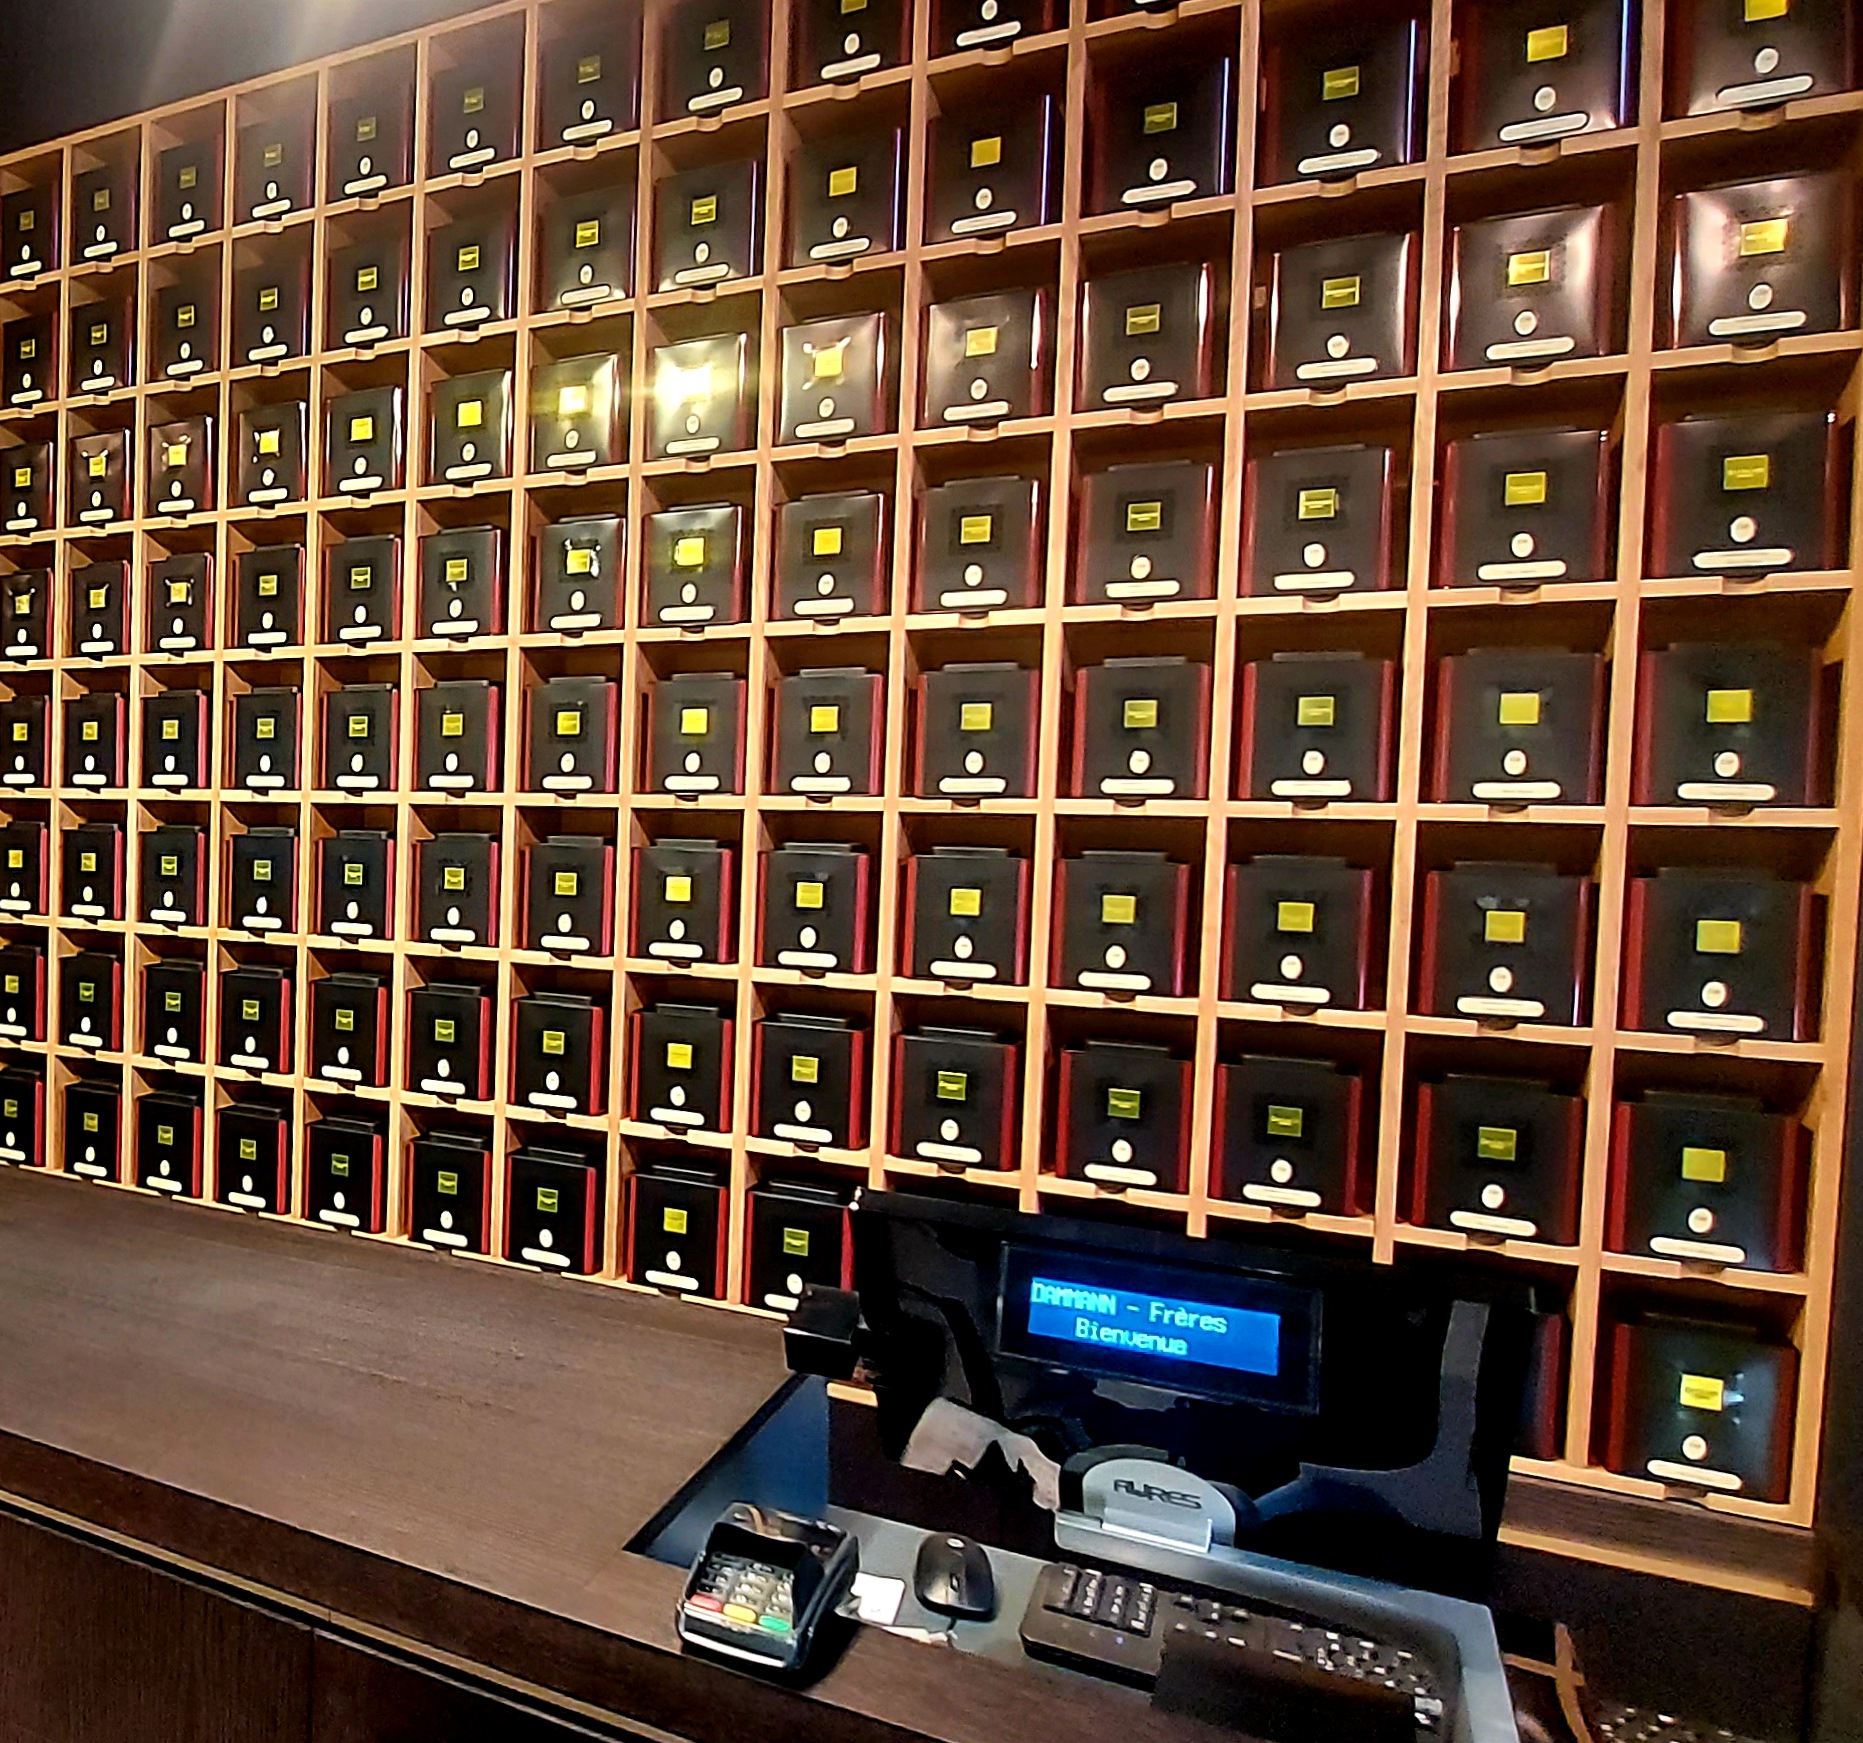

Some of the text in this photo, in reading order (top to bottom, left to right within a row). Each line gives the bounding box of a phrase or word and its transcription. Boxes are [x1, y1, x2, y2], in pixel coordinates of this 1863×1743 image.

[1031, 1282, 1117, 1315] DAMMANN
[1149, 1301, 1228, 1333] Frères
[1114, 1479, 1202, 1509] AURES
